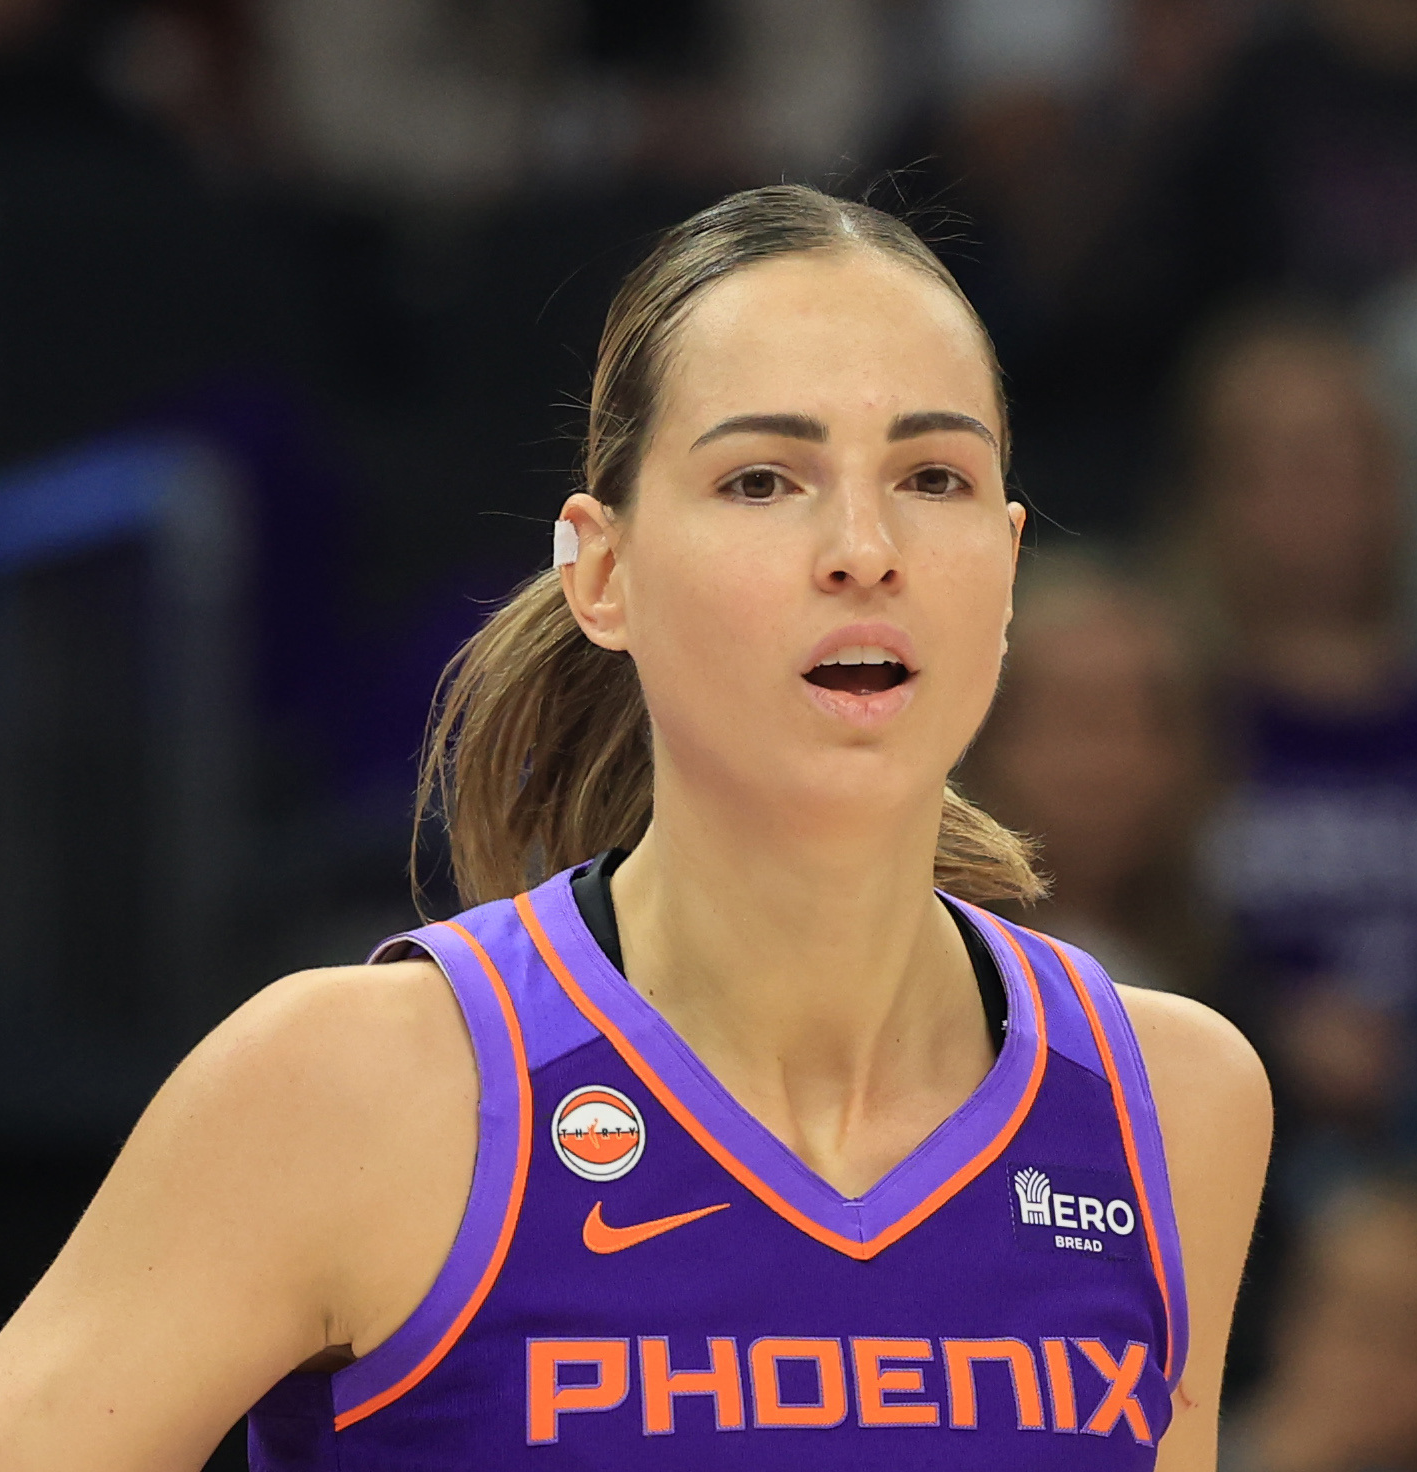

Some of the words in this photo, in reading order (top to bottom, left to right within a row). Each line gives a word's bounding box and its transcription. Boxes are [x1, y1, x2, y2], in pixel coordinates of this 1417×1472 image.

[1014, 1167, 1135, 1235] HERO
[1055, 1235, 1102, 1252] BREAD
[526, 1335, 1153, 1446] PHOENIX
